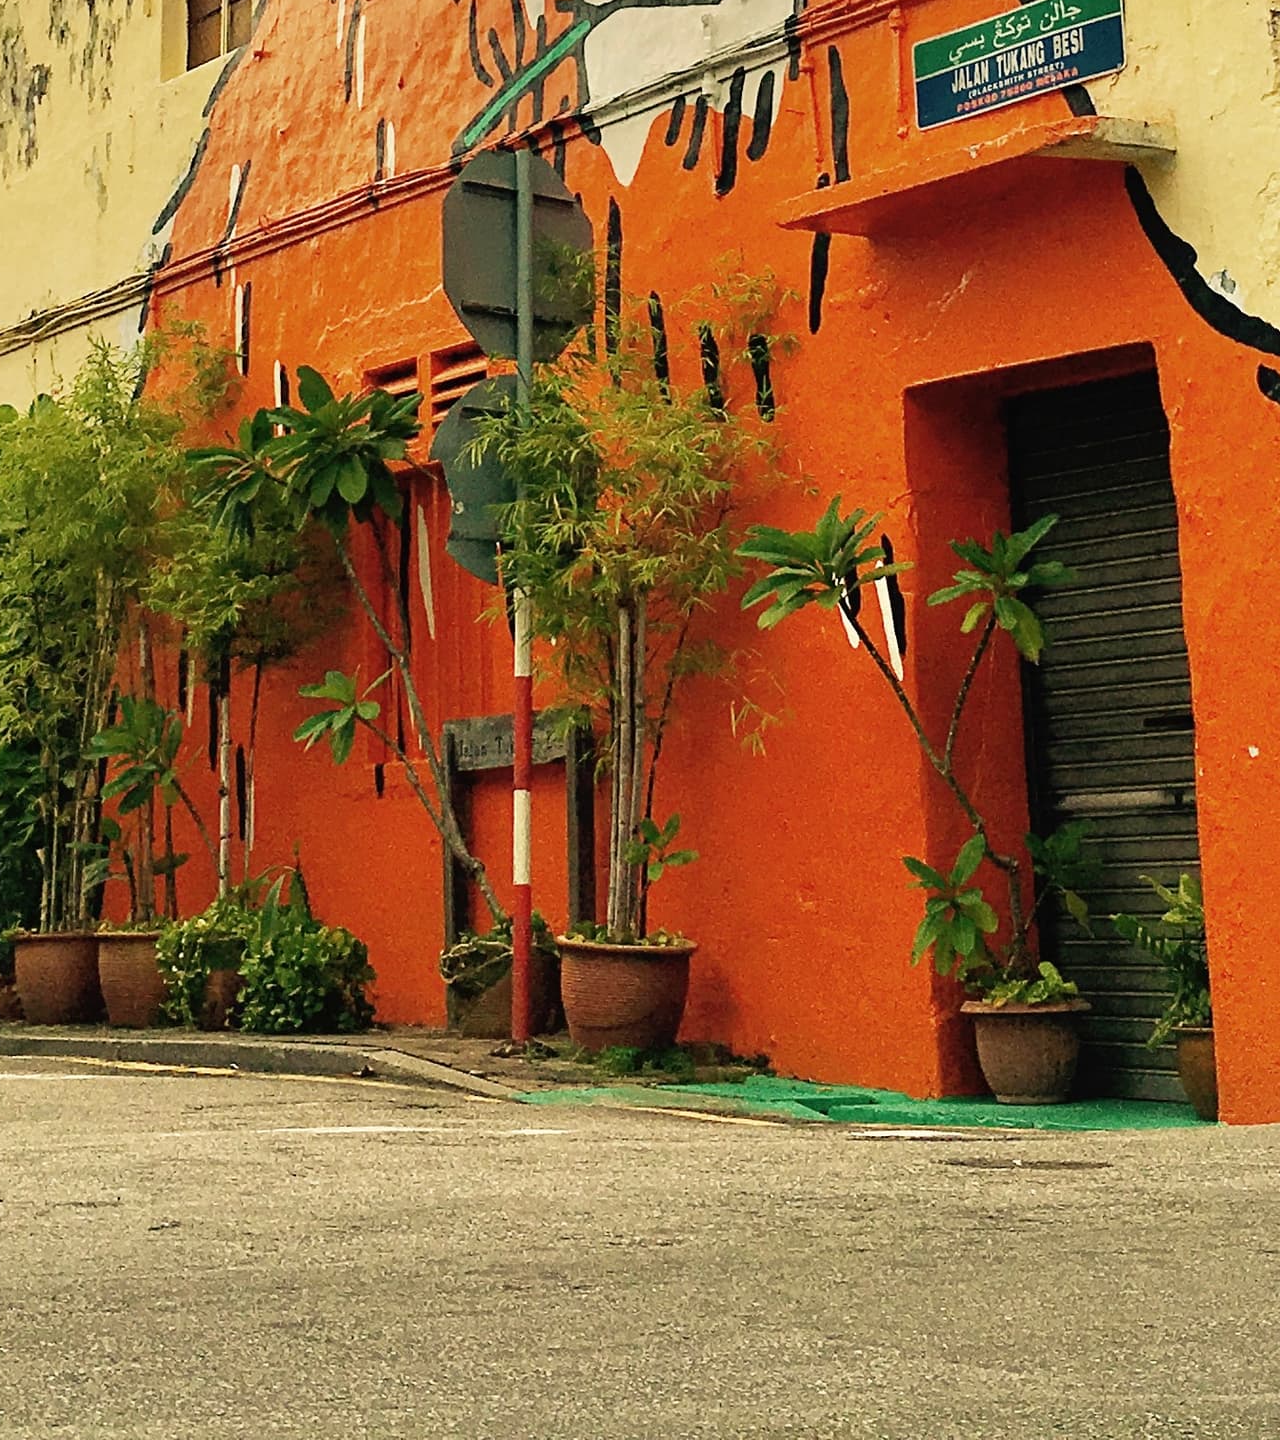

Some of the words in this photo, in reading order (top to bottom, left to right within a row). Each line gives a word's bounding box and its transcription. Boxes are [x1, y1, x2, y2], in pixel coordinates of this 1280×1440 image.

[951, 60, 989, 94] JALAN
[996, 40, 1046, 78] TUKANG
[1052, 27, 1084, 60] BESI
